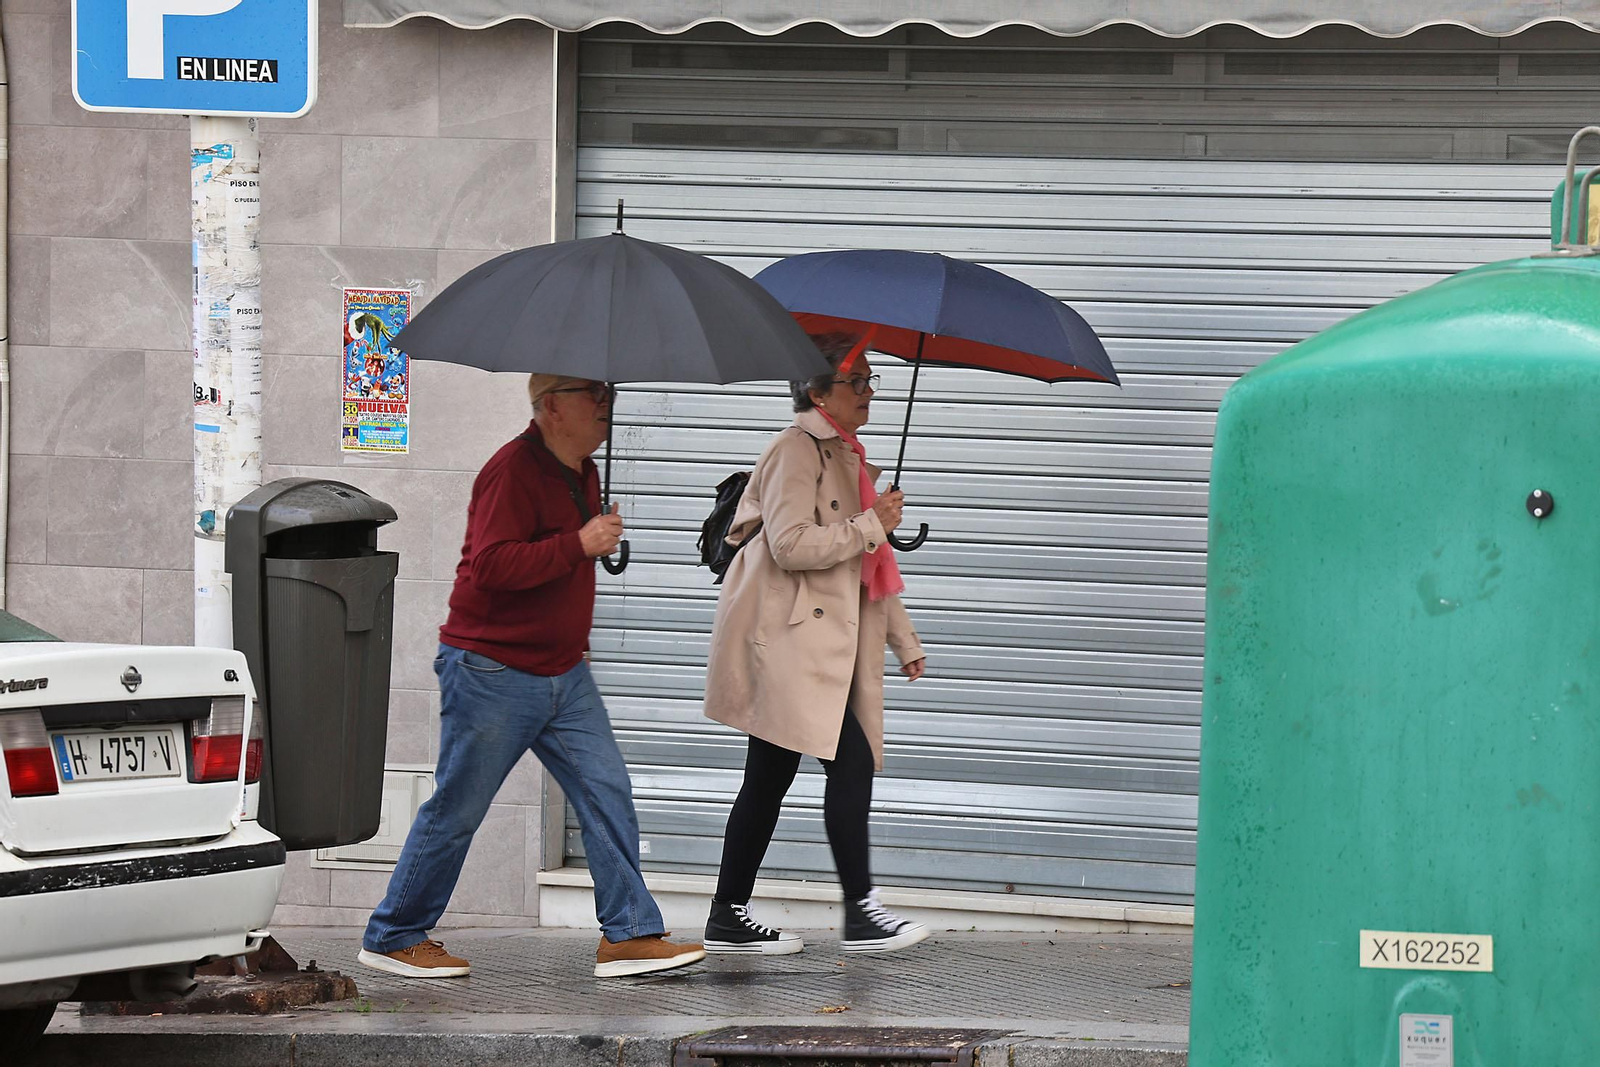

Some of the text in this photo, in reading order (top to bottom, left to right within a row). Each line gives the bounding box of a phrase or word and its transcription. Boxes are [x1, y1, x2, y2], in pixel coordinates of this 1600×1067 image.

[180, 57, 274, 82] EN LINEA
[344, 405, 358, 414] 30
[358, 403, 408, 414] HUELVA
[348, 427, 354, 437] 1
[68, 740, 88, 775] H
[100, 736, 146, 773] 4757
[157, 735, 172, 770] V
[1372, 938, 1480, 965] X162252
